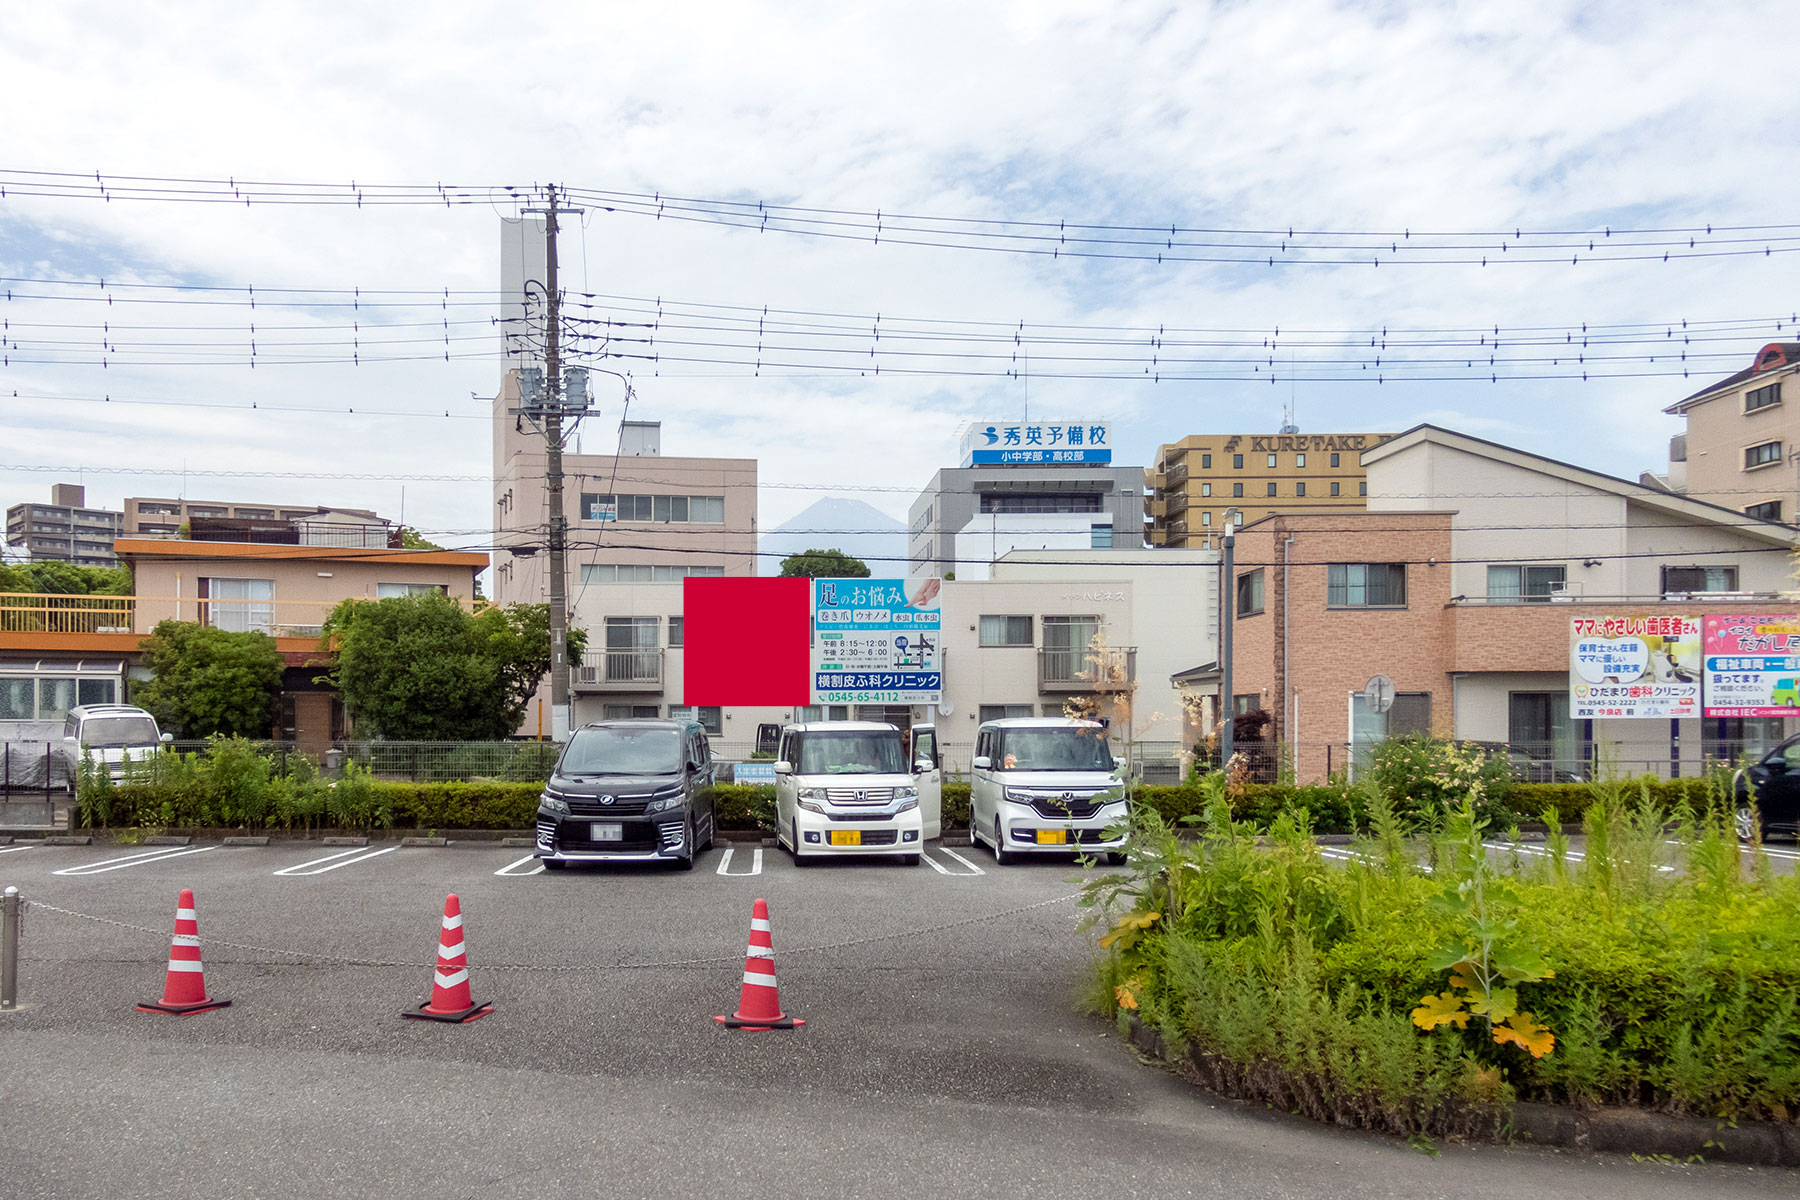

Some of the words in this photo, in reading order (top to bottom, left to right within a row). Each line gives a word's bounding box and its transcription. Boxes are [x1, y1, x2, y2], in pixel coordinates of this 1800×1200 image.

[1003, 425, 1106, 446] 秀英予備校
[1250, 435, 1367, 452] KURETAKE
[1001, 450, 1085, 462] 小中学部・高校部
[818, 583, 902, 607] 足のお悩み
[821, 611, 850, 621] 巻き爪
[855, 611, 888, 621] ウオノメ
[895, 614, 910, 622] 水虫
[915, 613, 938, 622] 爪水虫
[1573, 617, 1698, 635] ママにやさしい歯医者さん
[1578, 644, 1638, 653] 保育士さん在籍
[1578, 654, 1626, 663] ママに優しい
[818, 674, 939, 688] 横割皮ふ科クリニック
[828, 692, 899, 702] 0545-65-4112
